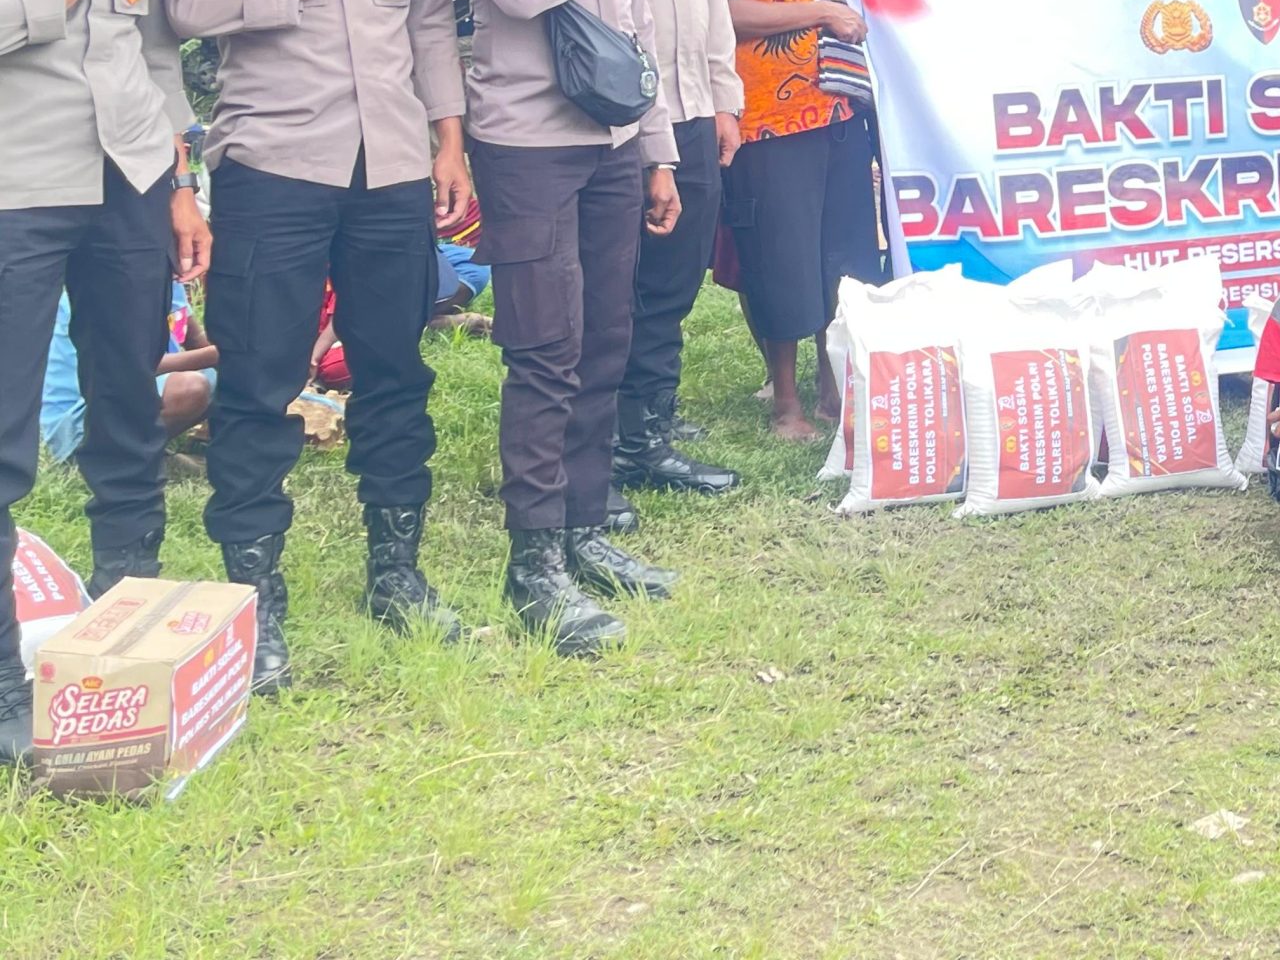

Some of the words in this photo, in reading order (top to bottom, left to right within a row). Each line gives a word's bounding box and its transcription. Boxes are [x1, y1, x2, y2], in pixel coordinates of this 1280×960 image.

[993, 78, 1225, 150] BAKTI
[905, 362, 917, 400] POLRI
[922, 359, 935, 427] TOLIKARA
[1028, 362, 1041, 400] POLRI
[1044, 360, 1060, 427] TOLIKARA
[1175, 355, 1190, 392] BAKTI
[890, 376, 901, 424] SOSIAL
[1015, 376, 1027, 424] SOSIAL
[1141, 344, 1157, 393] POLRES
[1150, 396, 1167, 463] TOLIKARA
[1158, 343, 1177, 417] BARESKRIM
[1170, 421, 1183, 459] POLRI
[1182, 396, 1196, 443] SOSIAL
[891, 429, 902, 470] BAKTI
[908, 404, 919, 484] BARESKRIM
[925, 430, 936, 483] POLRES
[1019, 429, 1030, 471] BAKTI
[1033, 404, 1045, 484] BARESKRIM
[1052, 430, 1062, 483] POLRES
[57, 685, 148, 717] SELERA
[53, 707, 137, 744] PEDAS
[86, 748, 115, 762] AYAM
[117, 743, 151, 758] PEDAS
